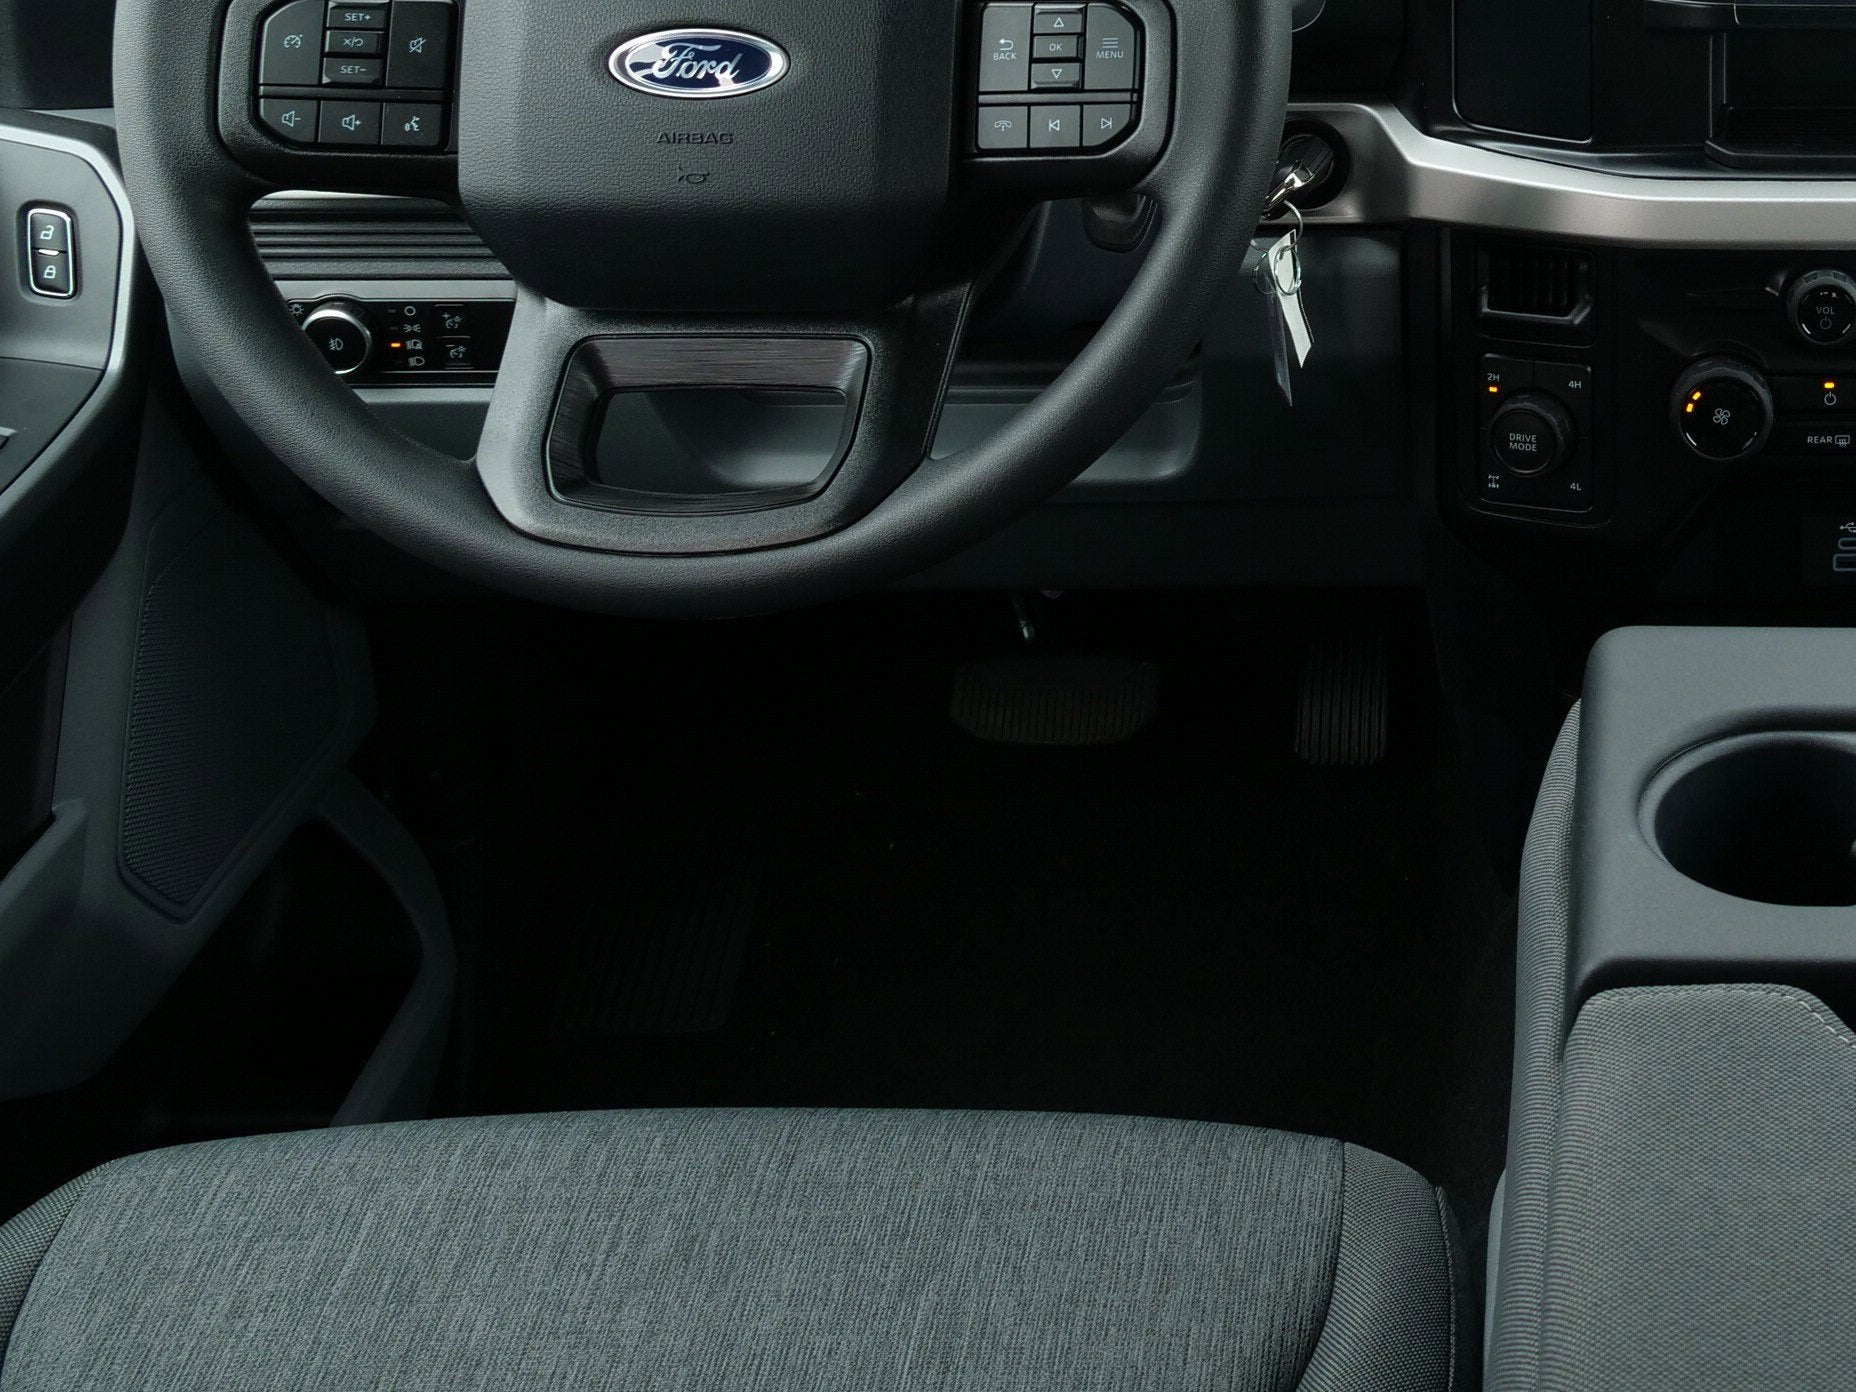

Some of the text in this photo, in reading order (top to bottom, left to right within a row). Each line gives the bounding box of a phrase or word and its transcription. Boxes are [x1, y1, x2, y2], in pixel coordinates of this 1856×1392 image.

[344, 12, 372, 22] SET+
[1049, 43, 1063, 51] OK
[993, 51, 1017, 61] BACK
[1096, 50, 1124, 59] MENU
[656, 131, 734, 145] AIRBAG
[1815, 306, 1836, 315] VOL
[1486, 372, 1500, 382] 2H
[1567, 380, 1583, 389] 4H
[1508, 433, 1538, 444] DRIVE
[1806, 435, 1833, 445] REAR
[1508, 442, 1538, 453] MODE
[1569, 482, 1582, 491] 4L
